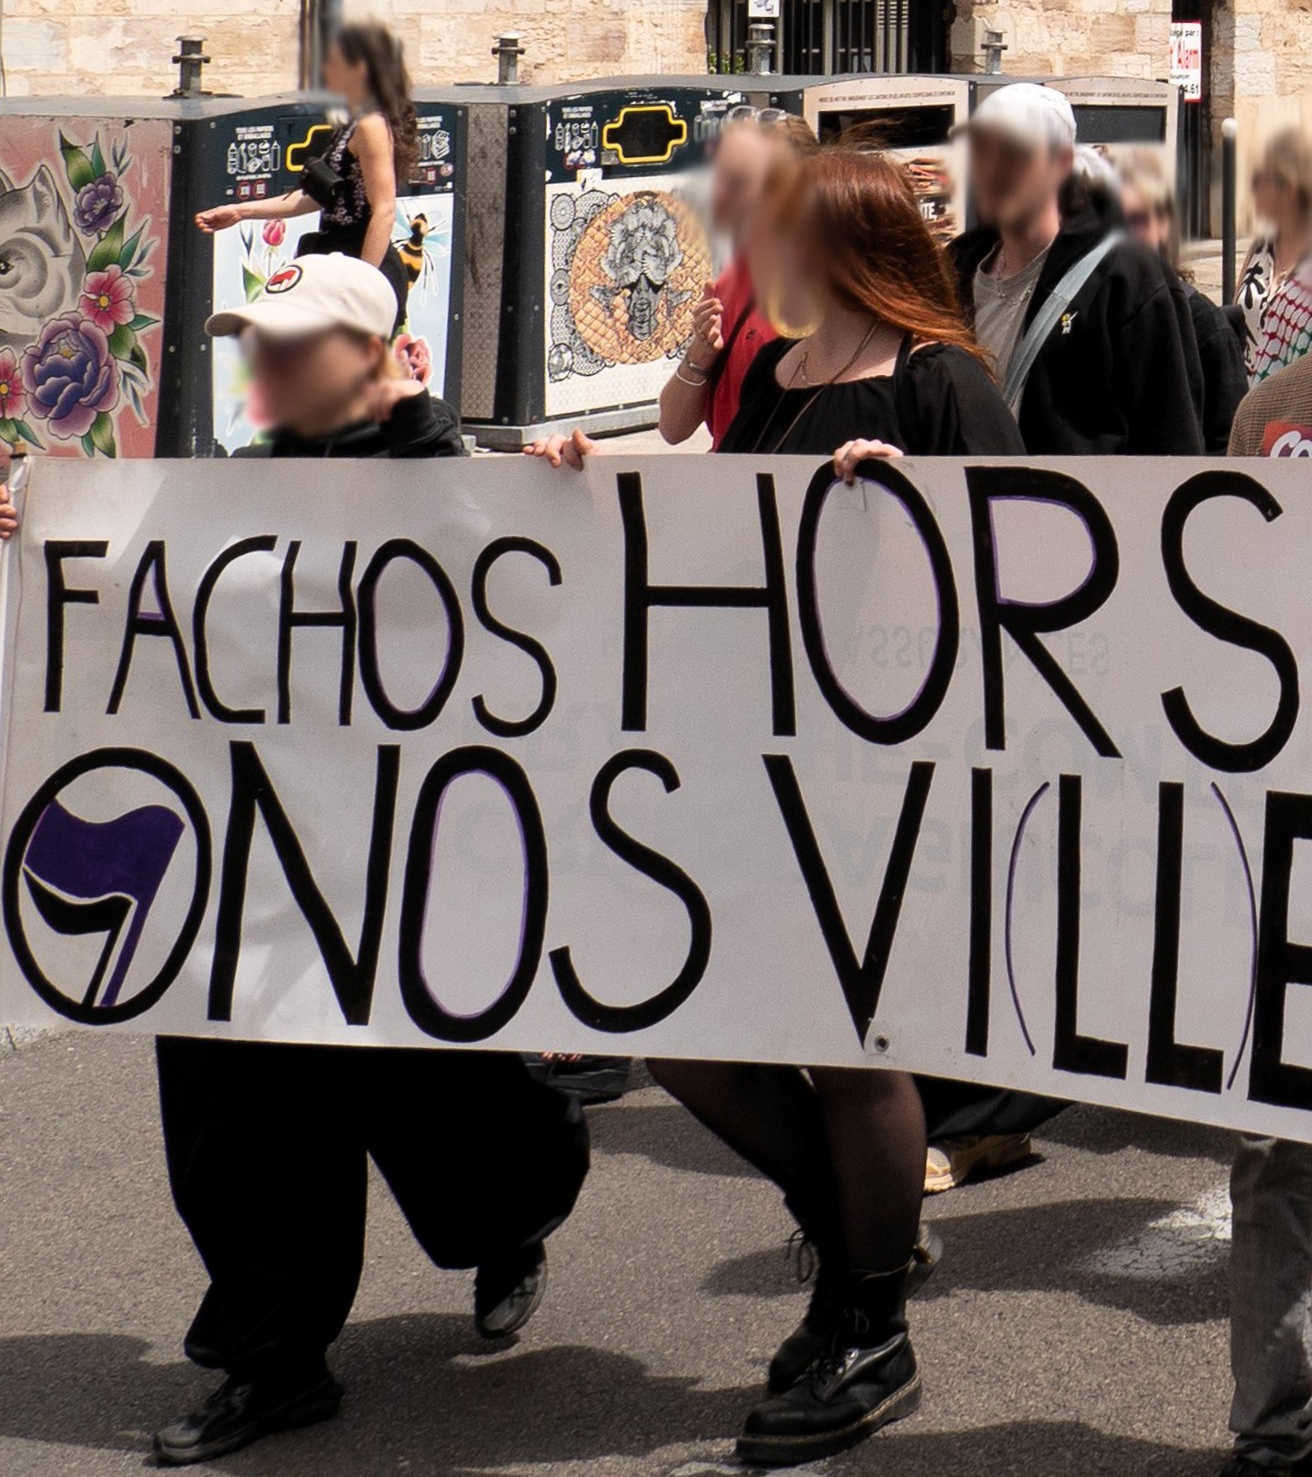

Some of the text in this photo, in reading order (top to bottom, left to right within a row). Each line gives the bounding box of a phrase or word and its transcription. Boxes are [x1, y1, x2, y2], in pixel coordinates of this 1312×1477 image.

[44, 534, 562, 738] FACHOS
[620, 460, 1300, 774] HORS
[207, 740, 712, 1044] NOS
